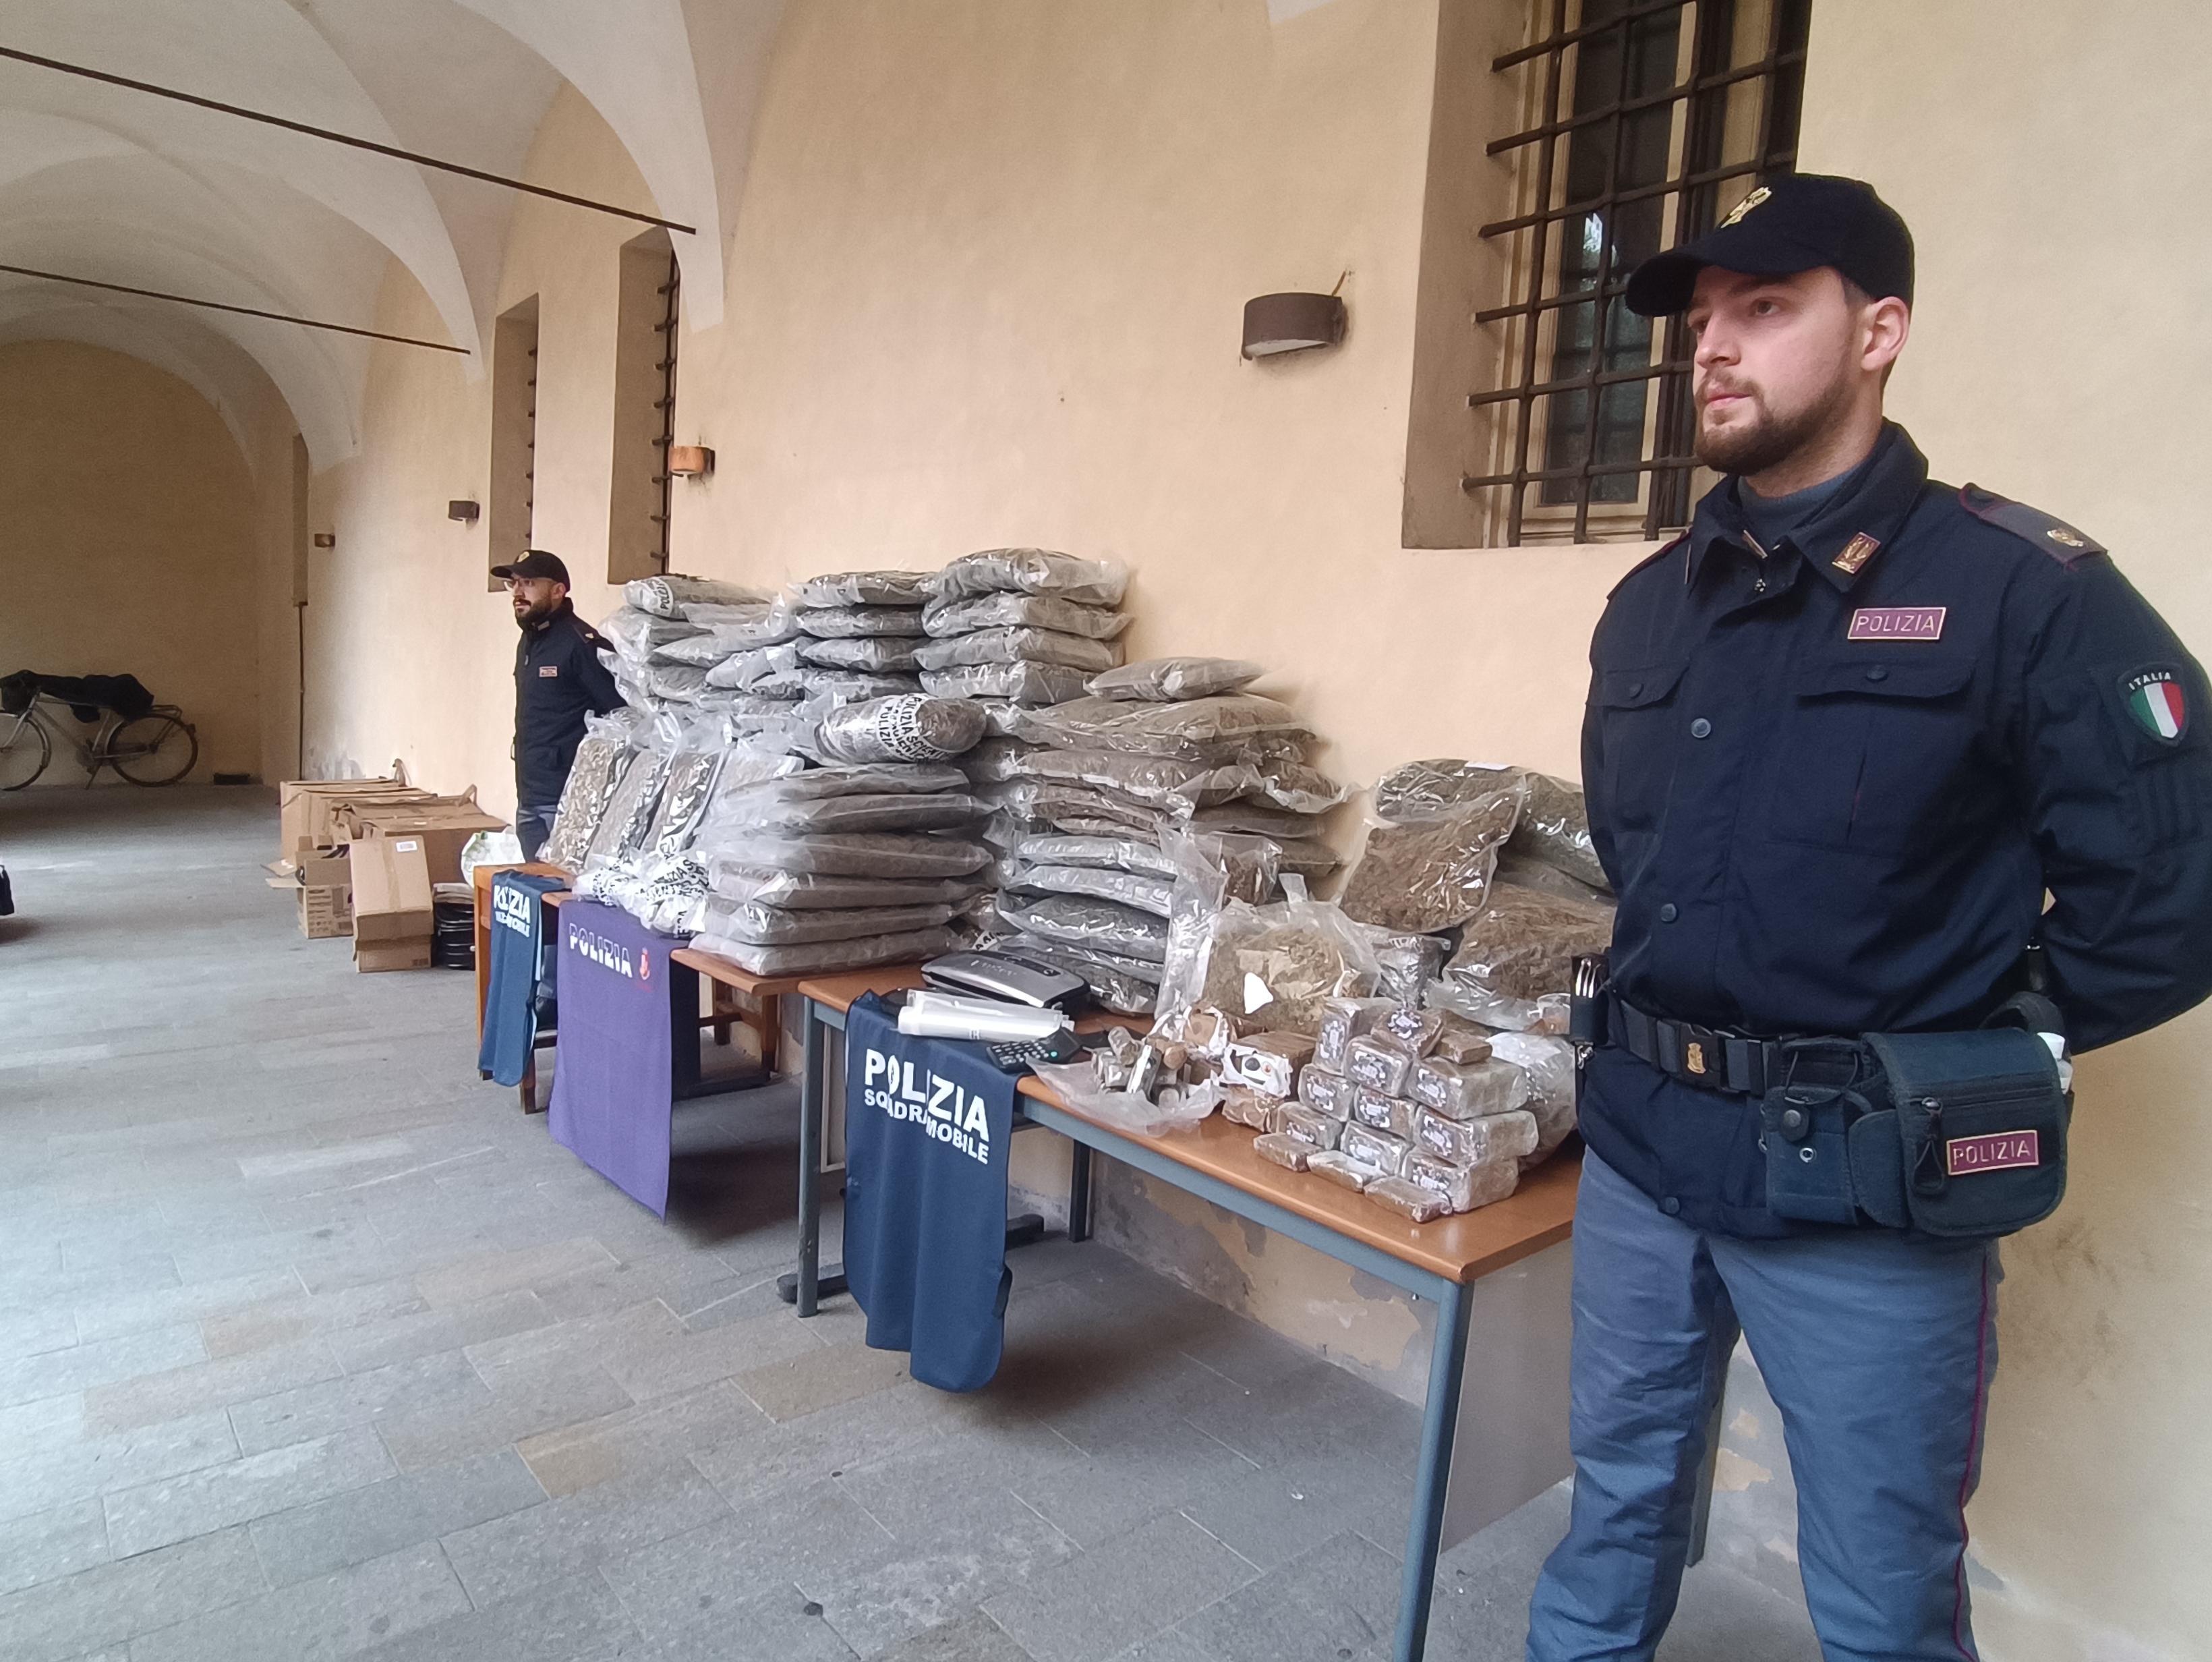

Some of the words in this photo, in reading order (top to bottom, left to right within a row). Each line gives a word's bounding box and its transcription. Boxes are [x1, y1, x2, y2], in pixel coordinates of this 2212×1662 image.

[1855, 614, 1934, 631] POLIZIA
[2128, 672, 2171, 690] ITALIA
[569, 923, 633, 979] POLIZIA
[865, 1089, 928, 1125] SQADR
[1953, 1140, 2031, 1166] POLIZIA
